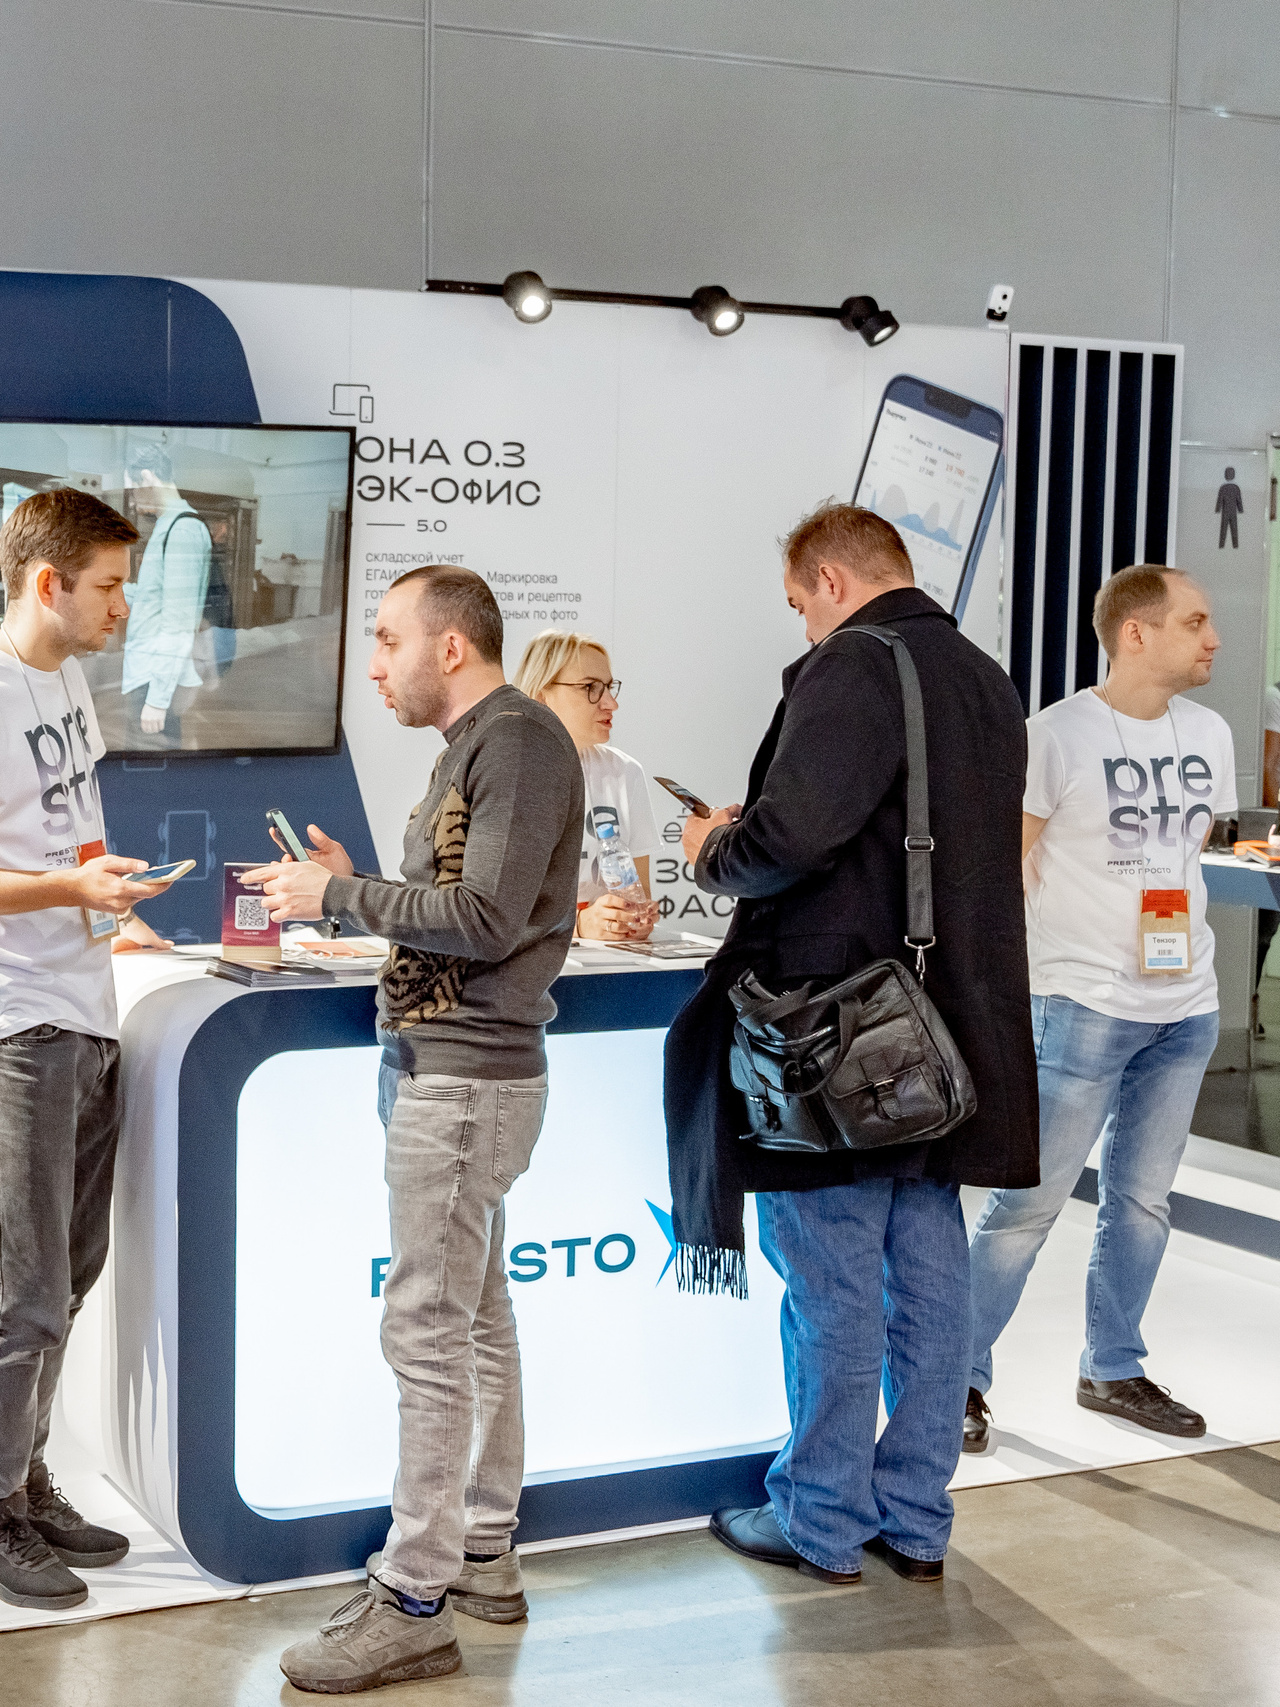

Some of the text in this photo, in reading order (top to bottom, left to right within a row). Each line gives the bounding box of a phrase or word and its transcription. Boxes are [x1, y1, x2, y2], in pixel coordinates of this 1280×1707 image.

[464, 440, 526, 468] 0.3
[356, 475, 541, 507] ЭК-ОФИС
[416, 519, 448, 533] 5.0
[365, 551, 433, 564] складской
[486, 571, 558, 585] Маркировка
[527, 591, 582, 605] рецептов
[533, 609, 547, 620] по
[550, 608, 579, 622] фото
[1102, 754, 1213, 812] pre
[1106, 795, 1214, 851] sto
